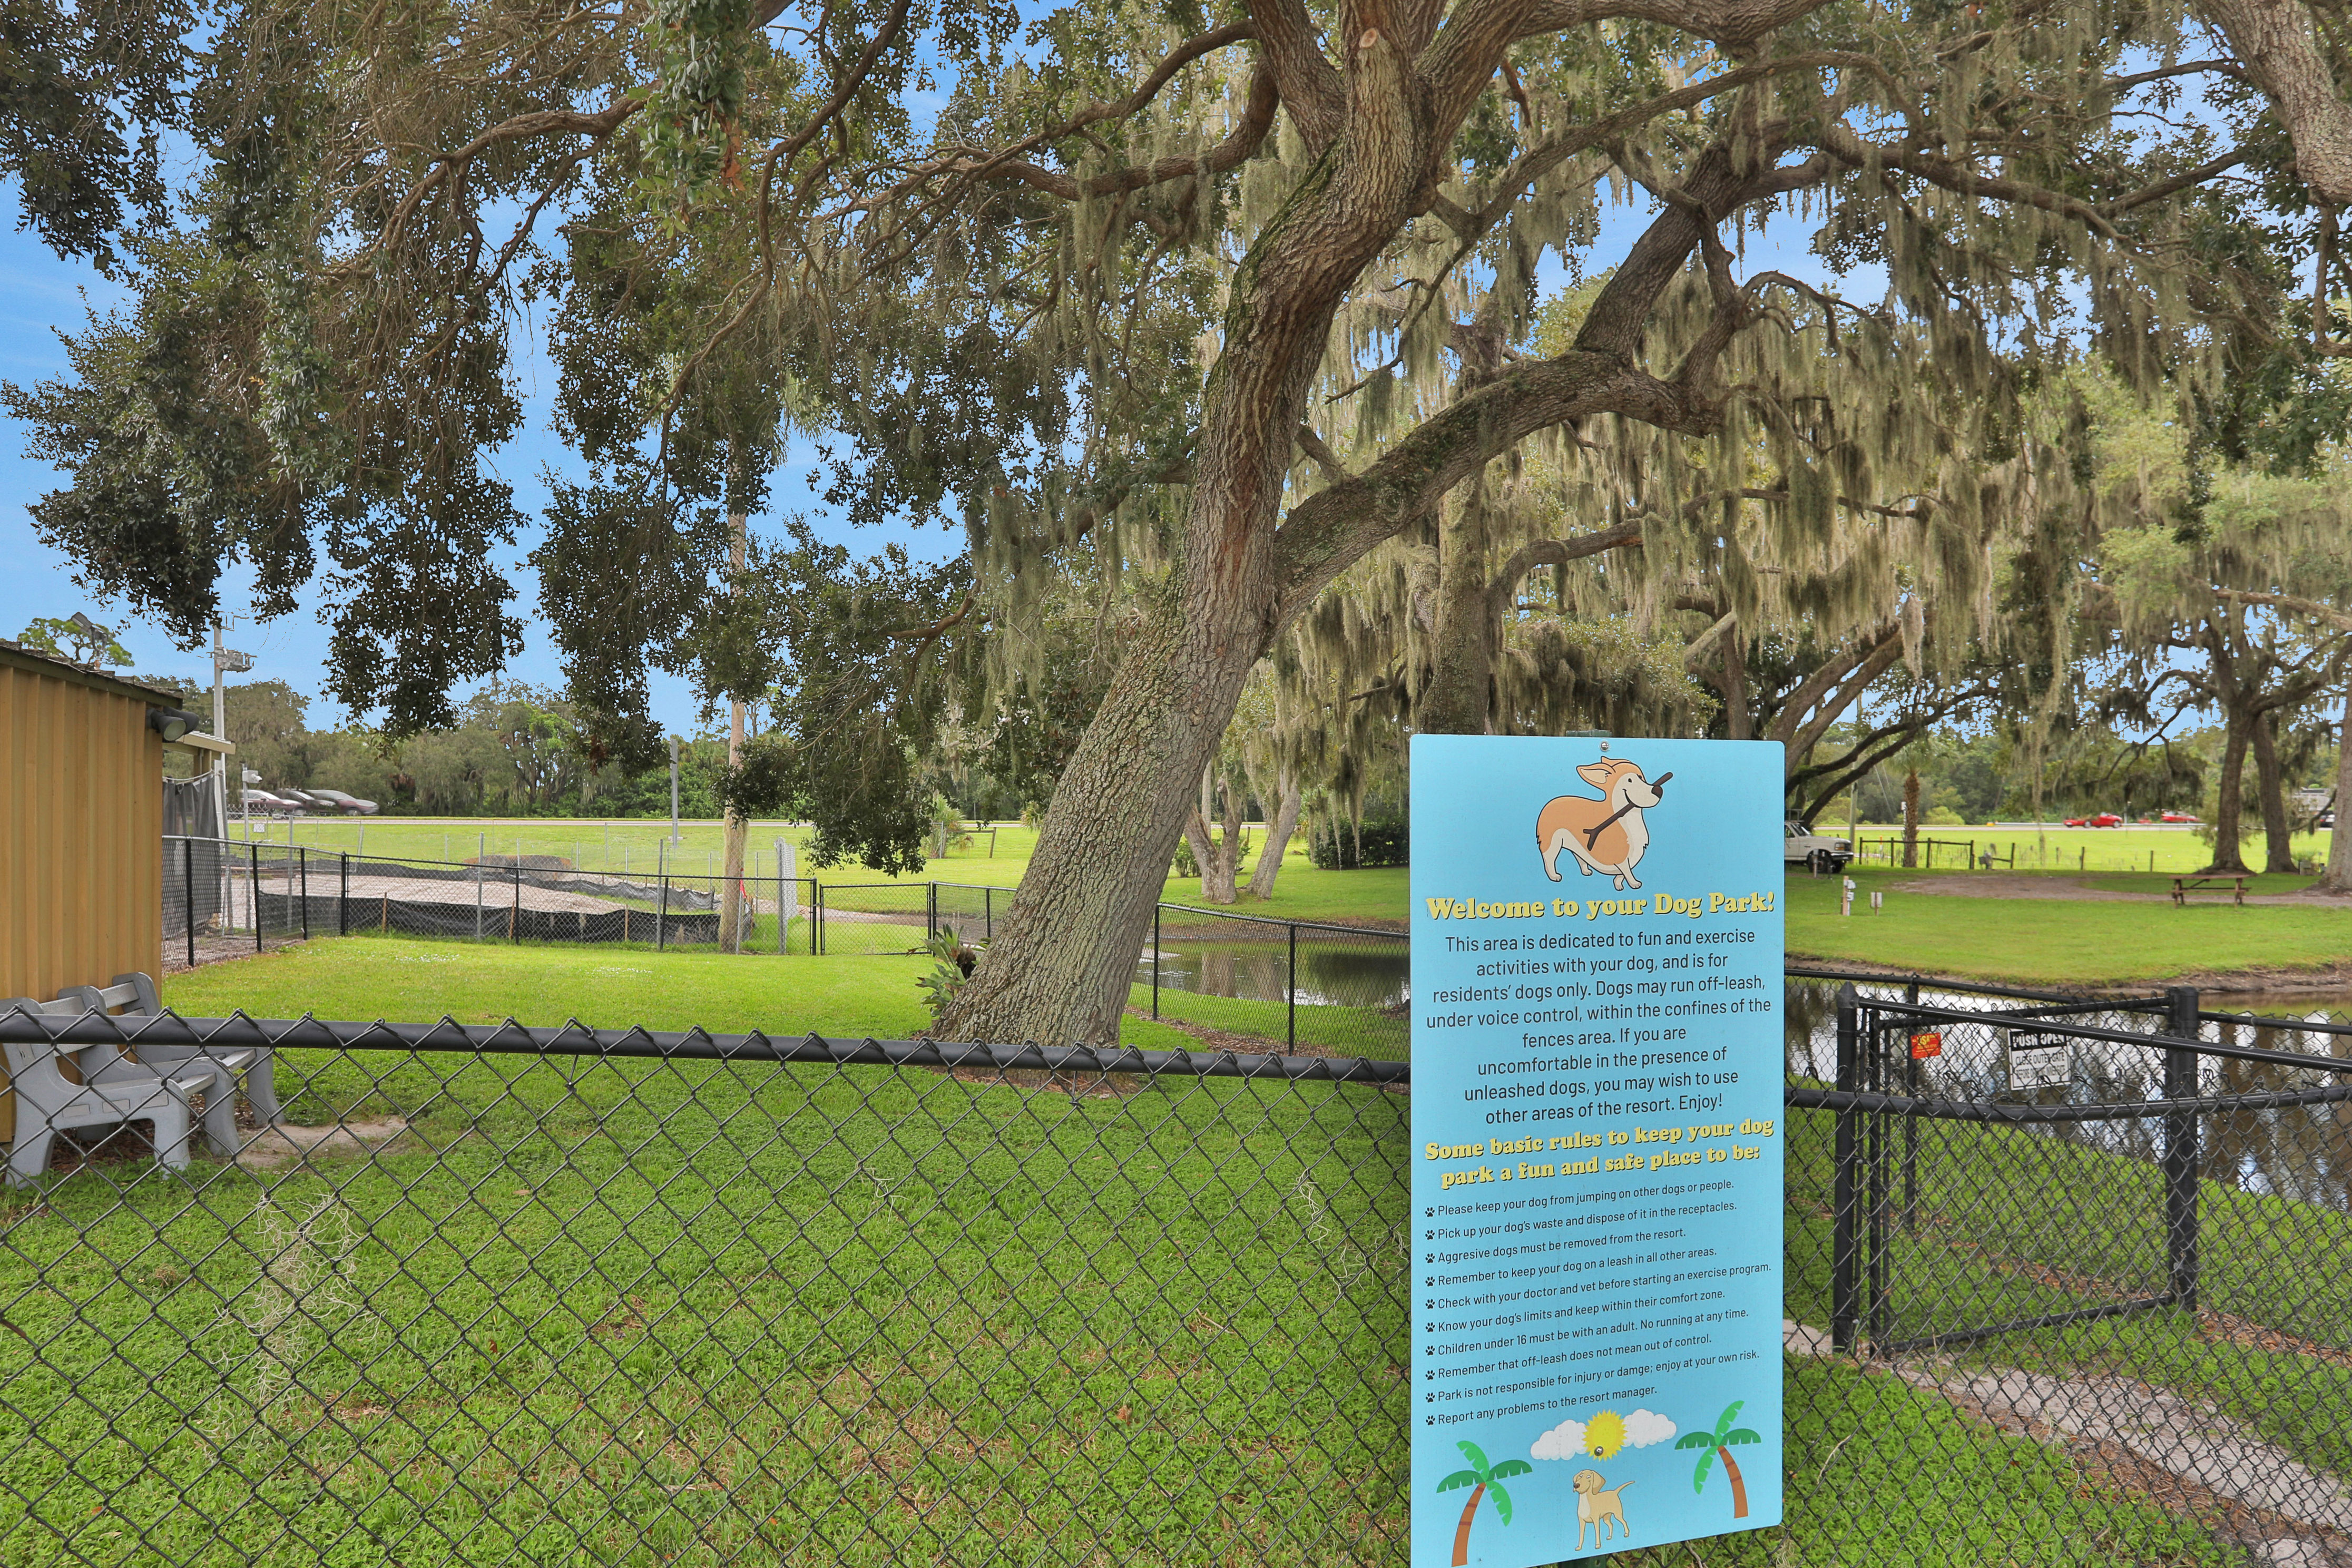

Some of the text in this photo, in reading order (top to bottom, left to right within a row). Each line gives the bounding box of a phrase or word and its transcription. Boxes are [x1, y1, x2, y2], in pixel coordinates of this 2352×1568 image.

[1426, 891, 1775, 922] Welcome to your Dog Park!
[1445, 928, 1755, 952] This area is dedicated to fun and exercise
[1476, 953, 1728, 976] activities with your dog, and is for
[1433, 974, 1765, 1003] residents' dogs only. Dogs may run off-leash,
[1427, 997, 1771, 1028] under voice control, within the confines of the
[1522, 1027, 1687, 1048] fences area. If you are
[2013, 1033, 2065, 1047] PUSH OPEN
[1478, 1046, 1727, 1075] uncomfortable in the presence of
[1465, 1072, 1738, 1101] unleashed dogs, you may wish to use
[1486, 1093, 1722, 1124] other areas of the resort. Enjoy!
[1425, 1119, 1774, 1161] Some basic rules to keep your dog
[1441, 1144, 1760, 1191] park a fun and safe place to be:
[1438, 1179, 1734, 1216] Please keep your dog from jumping on other dogs or people.
[1438, 1228, 1686, 1265] Aggresive dogs must be removed from the resort.
[1438, 1264, 1771, 1309] Check with your doctor and vet before starting an exercise program.
[1438, 1291, 1725, 1332] Know your dog's limits and keep within their comfort zone.
[1438, 1334, 1712, 1378] Remember that off-leash does not mean out of control.
[1438, 1349, 1759, 1402] Park is not responsible for injury or damge; enjoy at your own risk.
[1438, 1386, 1657, 1425] Report any problems to the resort manager.
